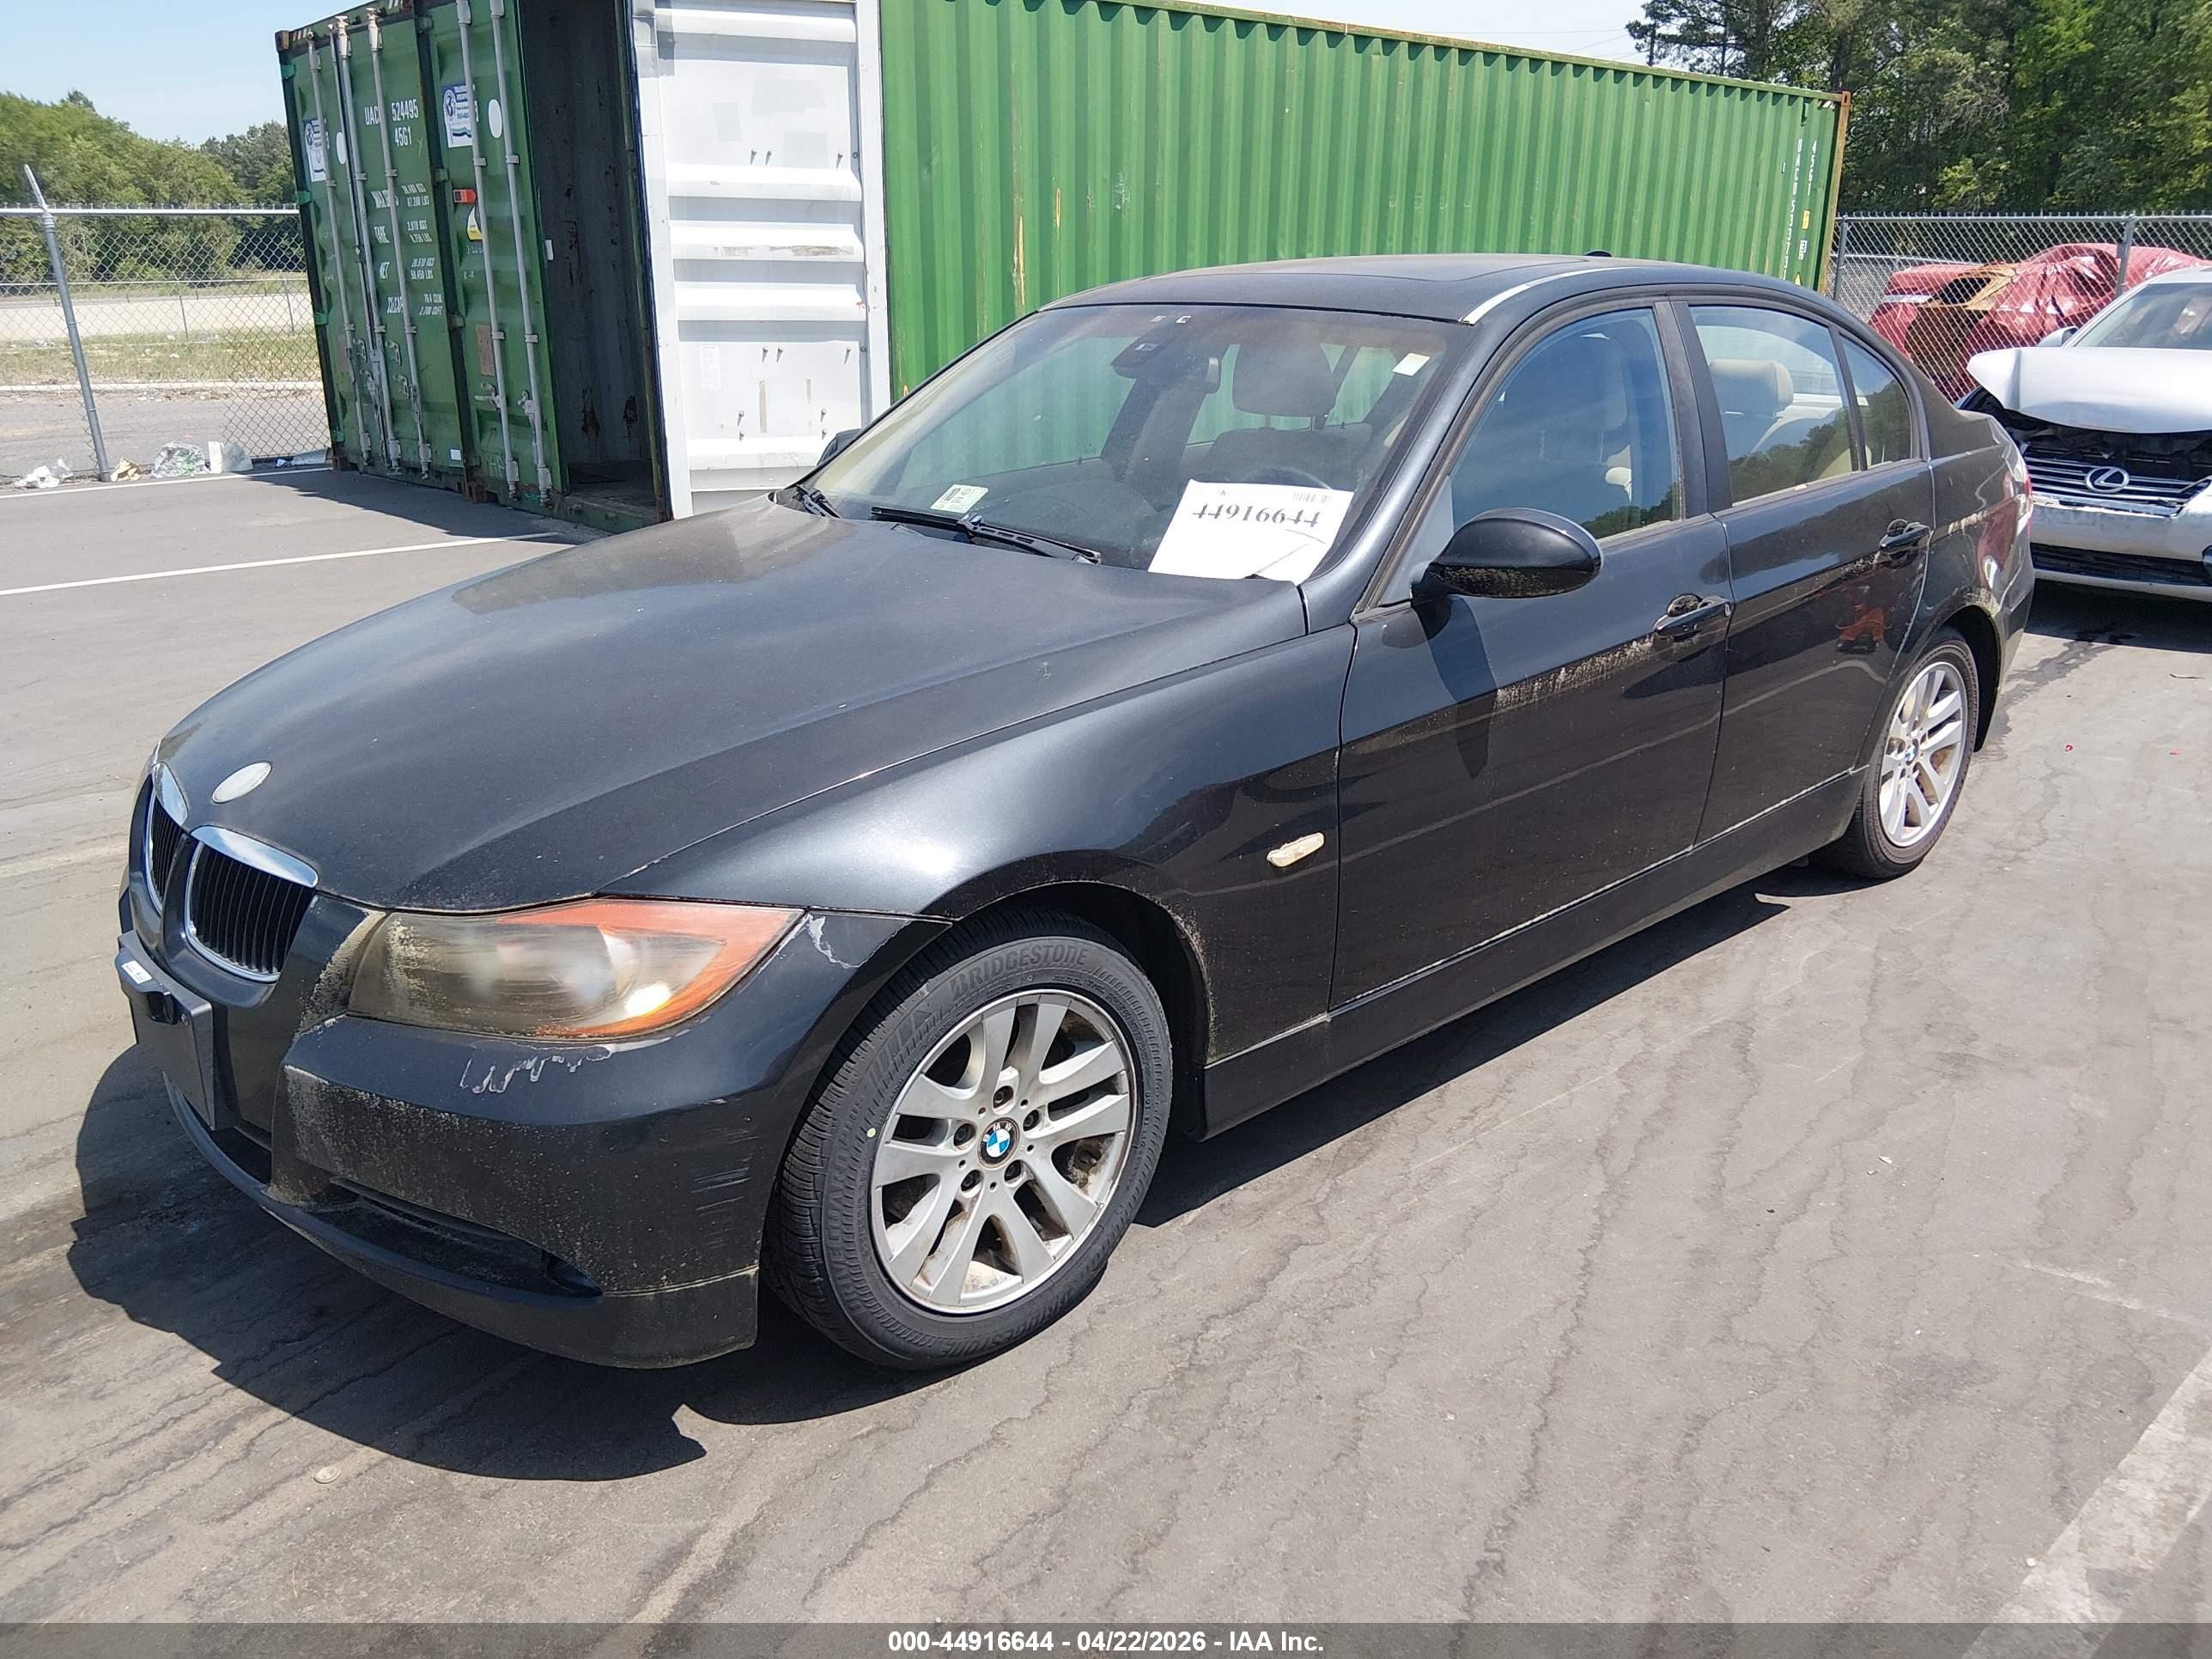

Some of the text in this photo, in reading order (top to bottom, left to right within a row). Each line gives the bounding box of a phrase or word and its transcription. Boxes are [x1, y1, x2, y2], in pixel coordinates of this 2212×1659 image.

[364, 99, 419, 125] UAC 524495
[395, 125, 412, 147] 45G1
[1792, 138, 1803, 196] UACU
[1808, 140, 1817, 197] 45G1
[374, 226, 390, 244] TARE
[380, 261, 390, 279] NET
[948, 945, 1089, 1000] BRIDGESTONE
[982, 1121, 1013, 1143] BMW
